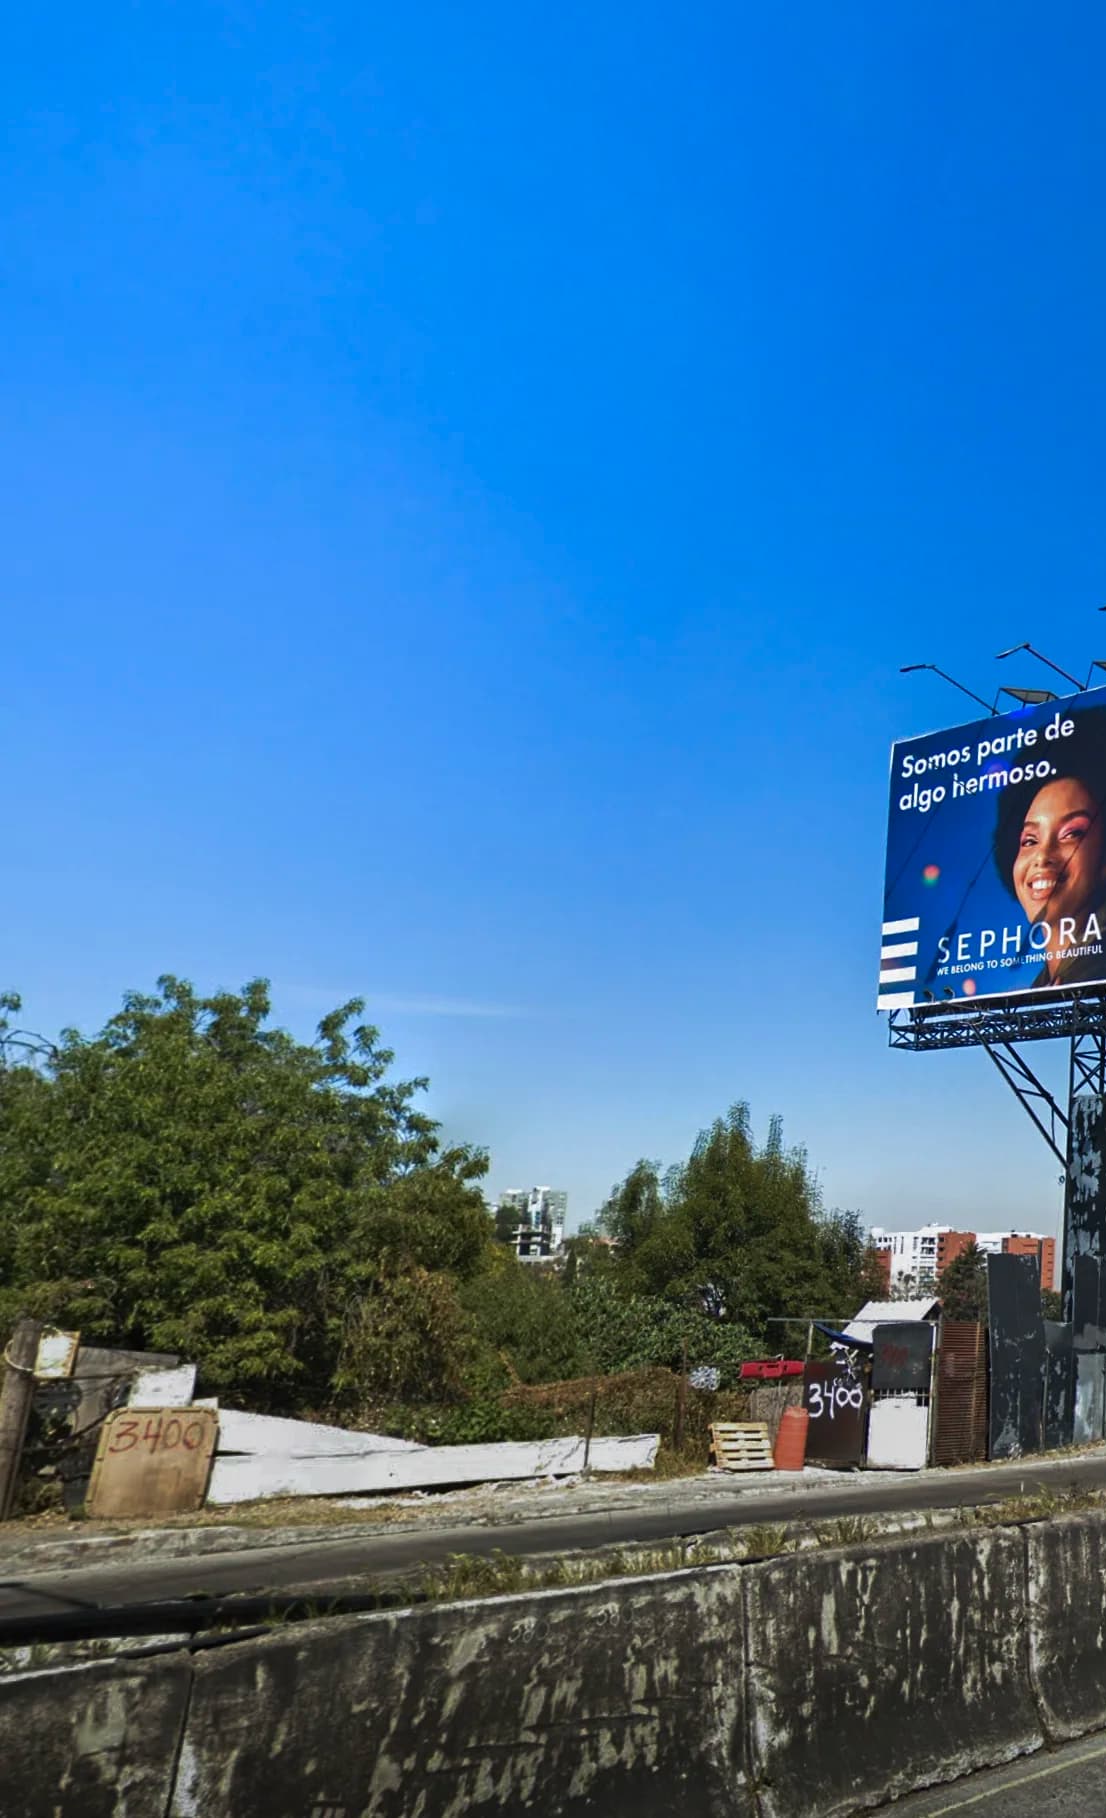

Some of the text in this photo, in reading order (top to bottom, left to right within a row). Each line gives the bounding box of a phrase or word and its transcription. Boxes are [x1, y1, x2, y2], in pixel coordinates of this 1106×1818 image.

[901, 713, 1075, 778] Somos parte de
[899, 761, 1057, 812] algo hermoso.
[937, 967, 949, 976] WE
[951, 962, 984, 974] BELONG
[987, 960, 998, 969] TO
[1056, 944, 1103, 959] BEAUTIFUL
[938, 913, 1102, 964] SEPHORA
[809, 1379, 863, 1419] 3400
[109, 1418, 204, 1454] 3400
